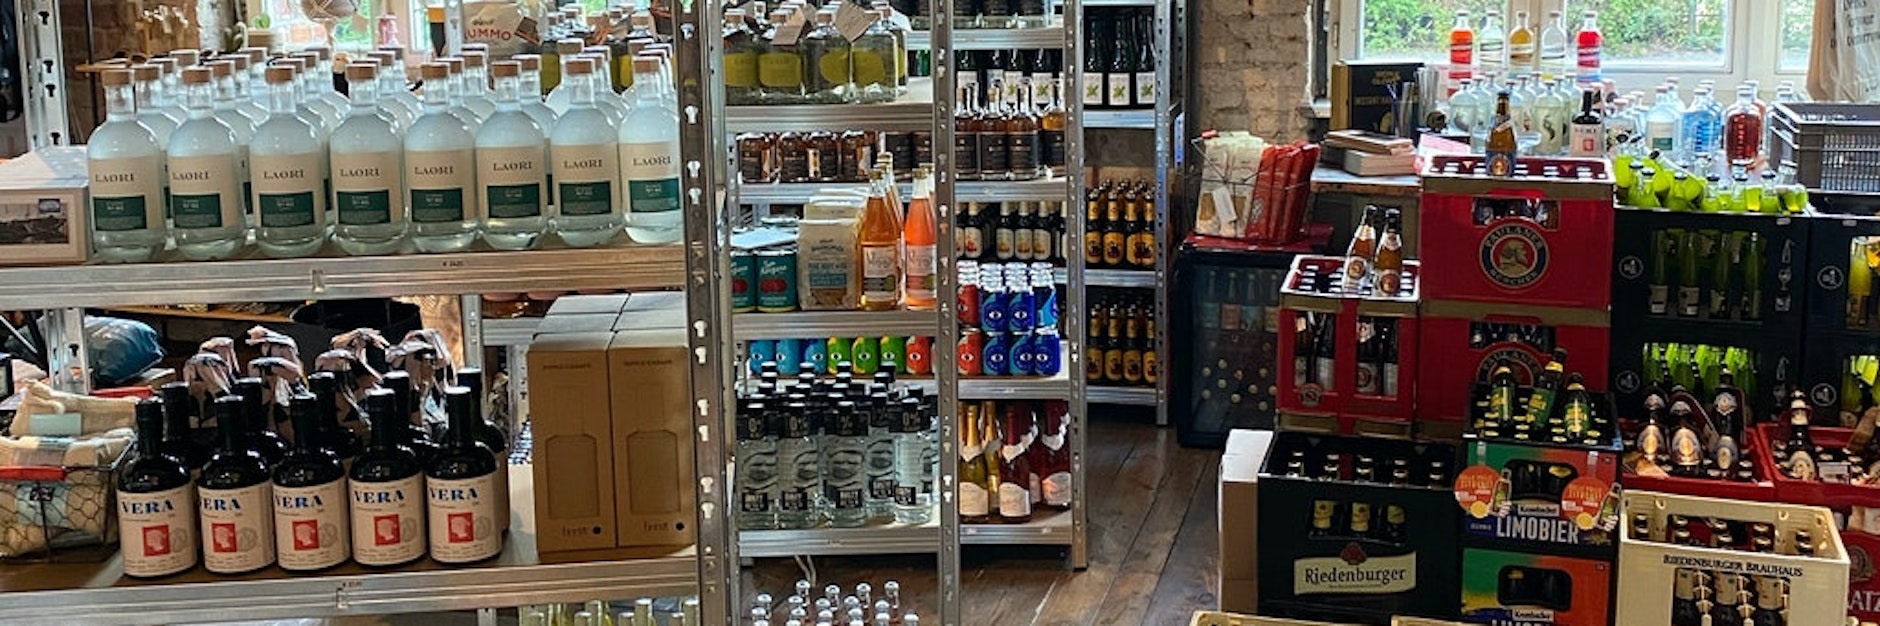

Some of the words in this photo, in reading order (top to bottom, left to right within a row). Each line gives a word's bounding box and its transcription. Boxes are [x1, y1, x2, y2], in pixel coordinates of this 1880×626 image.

[463, 29, 512, 41] UMMO
[493, 161, 533, 172] LAORI
[563, 159, 602, 169] LAORI
[632, 156, 671, 167] LAORI
[172, 170, 209, 181] LAORI
[264, 169, 304, 180] LAORI
[340, 168, 380, 178] LAORI
[414, 166, 454, 176] LAORI
[95, 173, 136, 183] LAORI
[1486, 226, 1544, 248] PAULANER
[353, 489, 403, 503] VERA
[430, 487, 478, 500] VERA
[121, 500, 173, 514] VERA
[200, 498, 241, 511] ERA
[1496, 516, 1579, 544] LIMOBIER
[1663, 555, 1743, 570] RIEDENBURGER
[1745, 562, 1802, 577] BRAUHAUS
[1305, 567, 1406, 584] Riedenburger
[1848, 590, 1880, 613] ATZ
